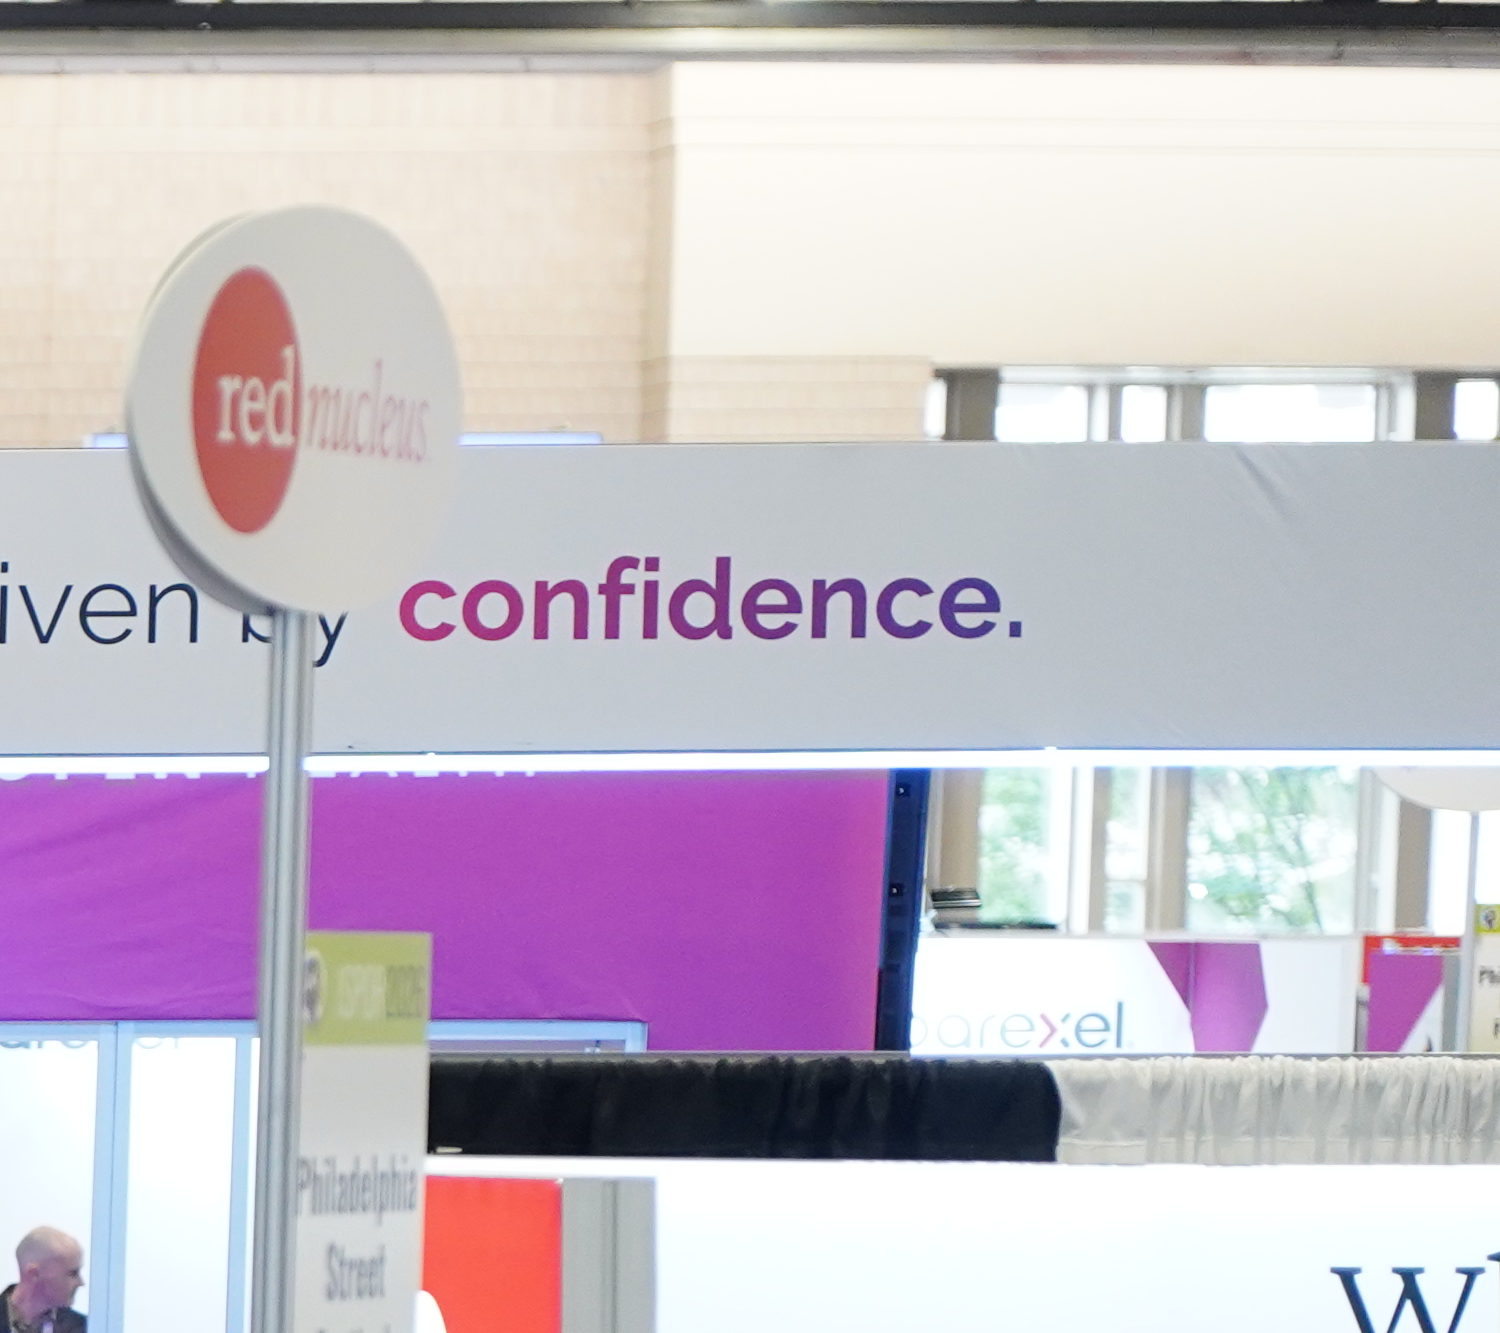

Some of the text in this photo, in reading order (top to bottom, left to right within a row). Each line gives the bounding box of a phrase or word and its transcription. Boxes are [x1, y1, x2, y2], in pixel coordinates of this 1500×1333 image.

[217, 343, 295, 446] red
[399, 556, 1022, 642] confidence.
[298, 1154, 419, 1225] Philadelphia
[326, 1242, 387, 1303] Street
